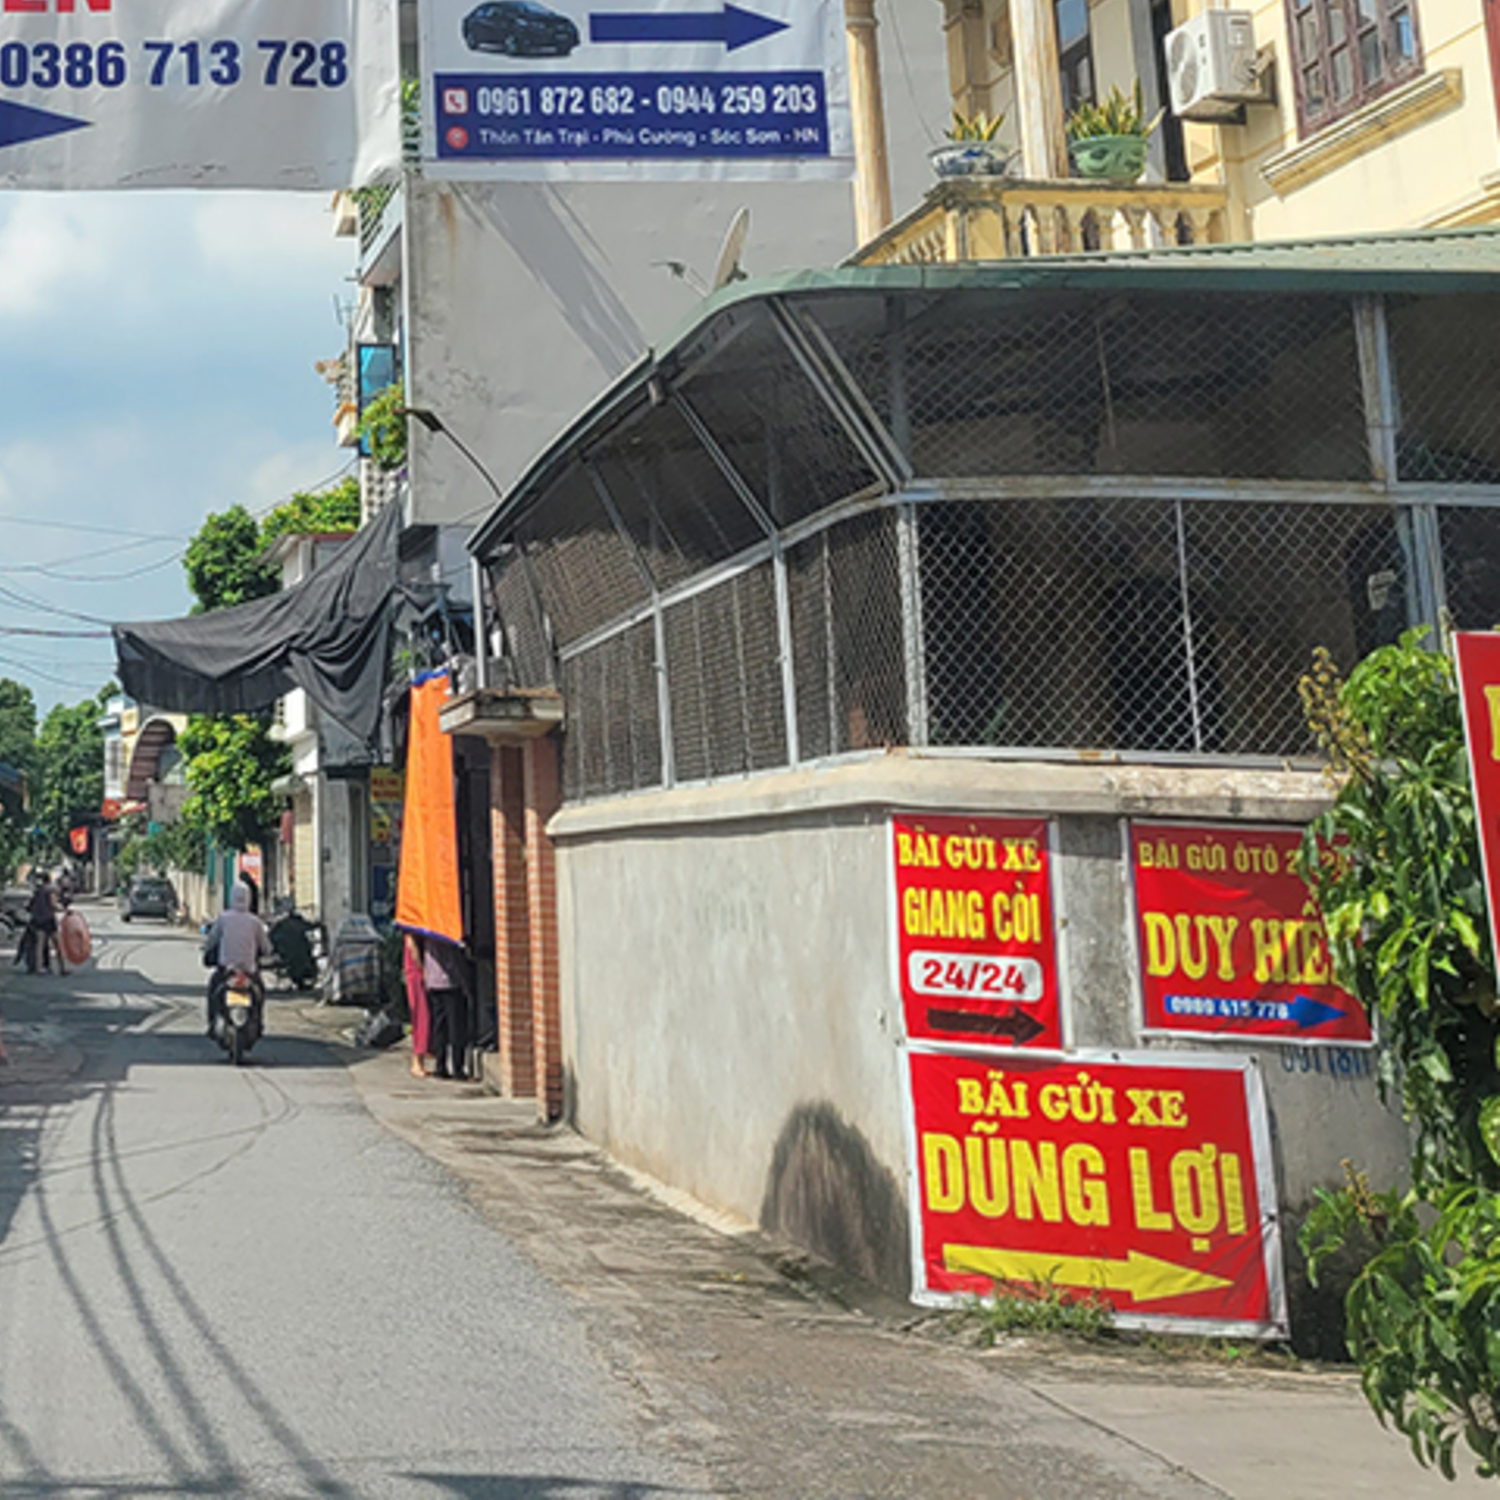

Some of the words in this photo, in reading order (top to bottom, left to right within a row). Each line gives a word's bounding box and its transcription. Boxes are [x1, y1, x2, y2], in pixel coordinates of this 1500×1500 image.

[0, 41, 126, 88] 0386
[144, 41, 241, 88] 713
[257, 41, 348, 88] 728
[476, 86, 532, 115] 0961
[540, 86, 585, 115] 872
[591, 86, 635, 114] 682
[657, 86, 715, 114] 0944
[722, 85, 766, 114] 259
[773, 85, 816, 113] 203
[1002, 837, 1041, 872] XE
[903, 887, 986, 940] GIANG
[992, 880, 1041, 943] CÒI
[1143, 911, 1239, 981] DUY
[922, 959, 1026, 994] 24/24
[957, 1070, 1030, 1118] BÃI
[1039, 1072, 1117, 1125] GỬI
[1127, 1089, 1188, 1127] XE
[922, 1121, 1110, 1226] DŨNG
[1129, 1143, 1247, 1253] LỢI
